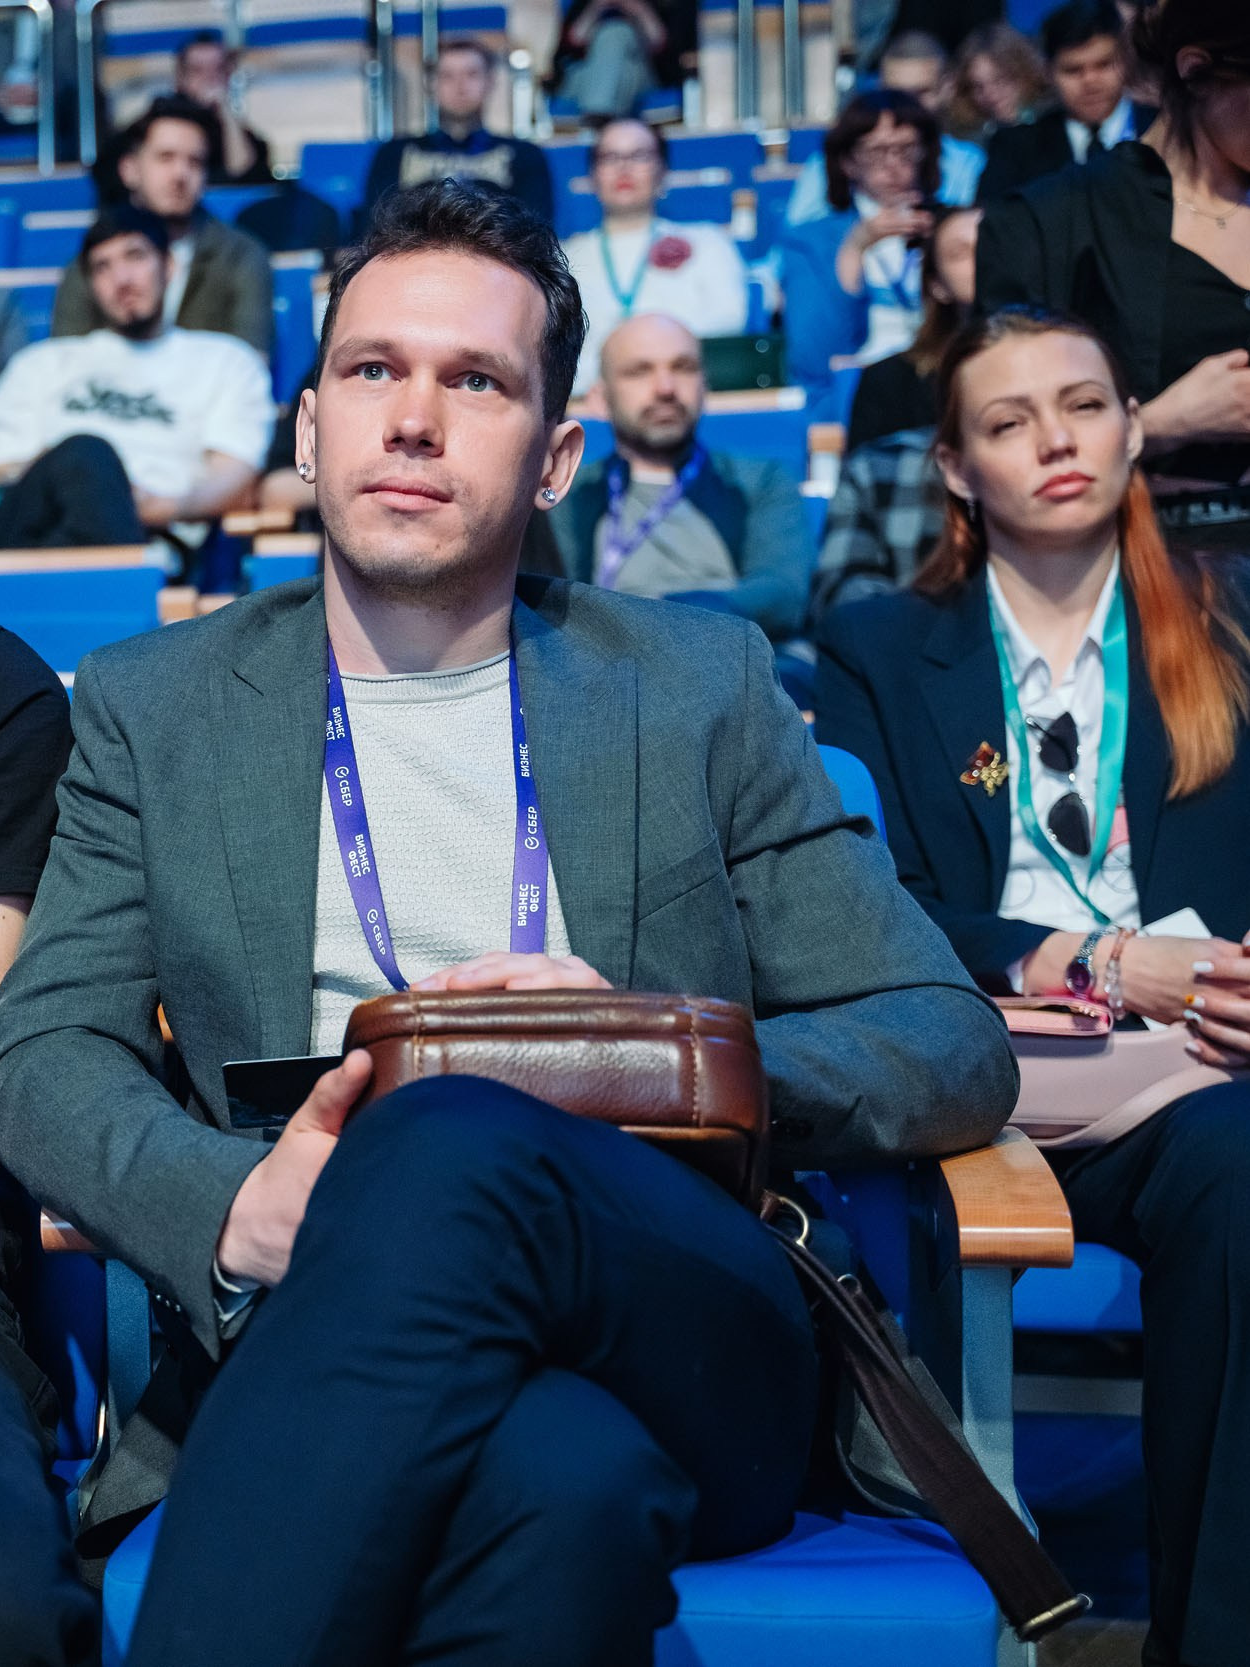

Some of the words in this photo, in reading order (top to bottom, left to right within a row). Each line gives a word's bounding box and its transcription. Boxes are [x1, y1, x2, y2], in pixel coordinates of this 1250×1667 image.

[332, 706, 345, 739] БИЗНЕС
[519, 743, 530, 777] БИЗНЕС
[339, 779, 353, 807] СБЕР
[527, 806, 537, 834] СБЕР
[348, 850, 361, 878] ФЕСТ
[354, 834, 370, 875] БИЗНЕС
[517, 883, 529, 927] БИЗНЕС
[529, 884, 540, 912] ФЕСТ
[372, 924, 386, 956] СБЕР
